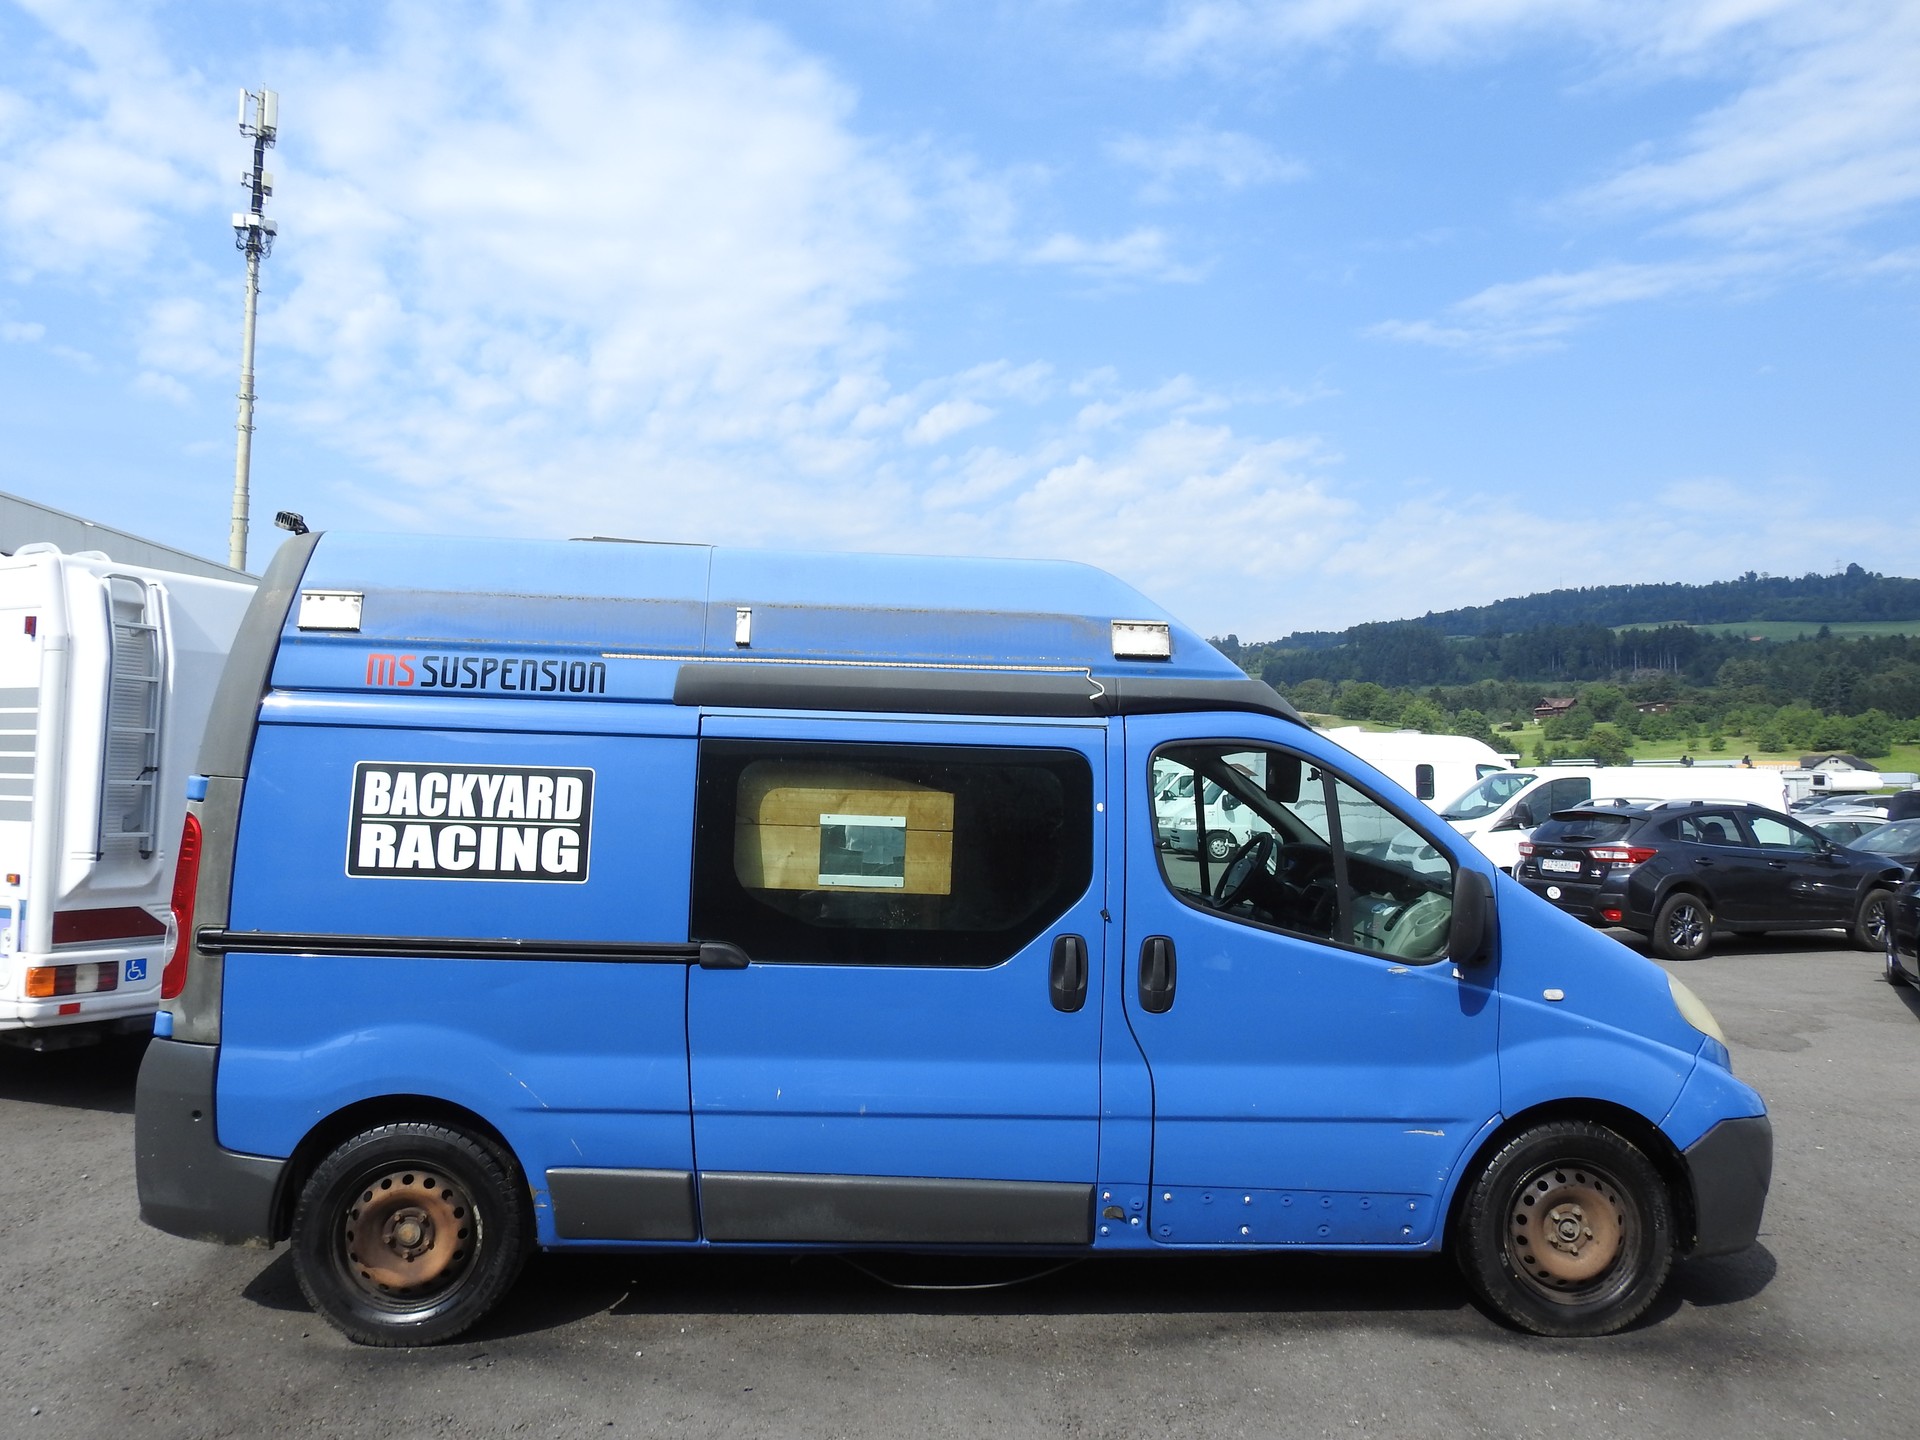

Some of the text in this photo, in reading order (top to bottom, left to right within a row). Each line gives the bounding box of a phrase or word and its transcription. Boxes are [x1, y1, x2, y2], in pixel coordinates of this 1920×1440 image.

[366, 653, 607, 694] MS SUSPENSION
[362, 770, 584, 820] BACKYARD
[357, 823, 580, 873] RACING
